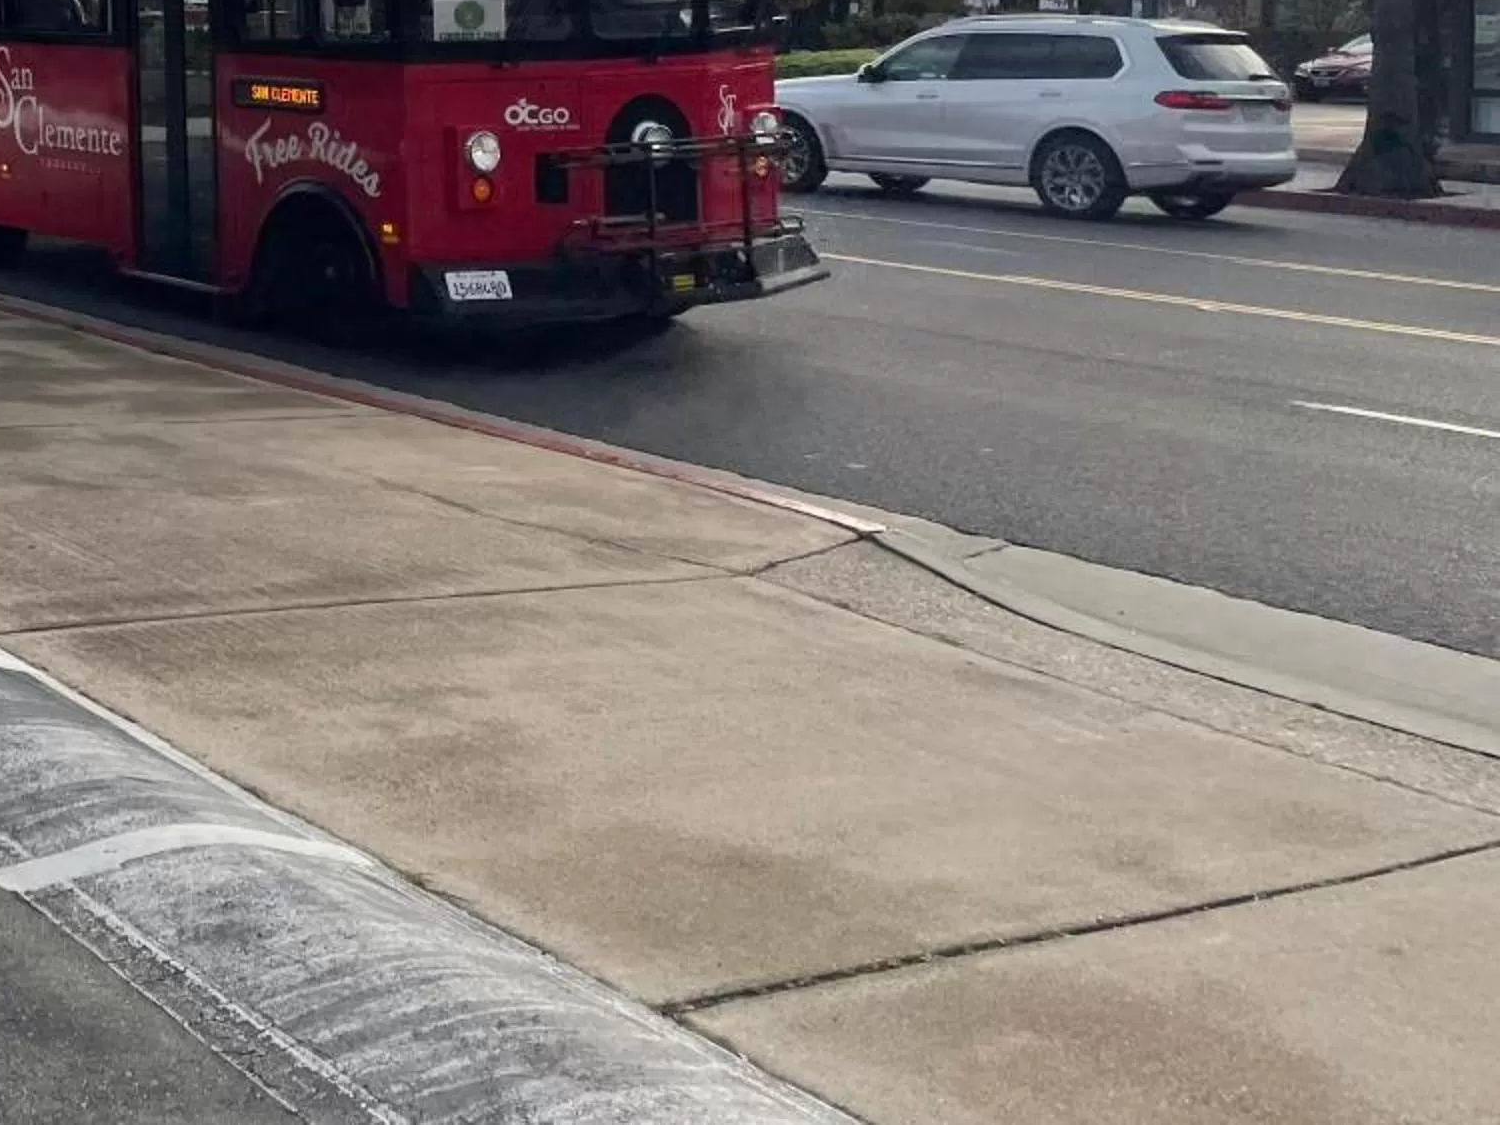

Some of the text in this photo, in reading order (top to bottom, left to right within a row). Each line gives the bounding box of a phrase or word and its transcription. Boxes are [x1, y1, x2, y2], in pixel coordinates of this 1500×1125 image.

[251, 84, 320, 105] SAN CLEMENTE
[13, 95, 123, 157] Clemente
[245, 116, 382, 198] Free Rides
